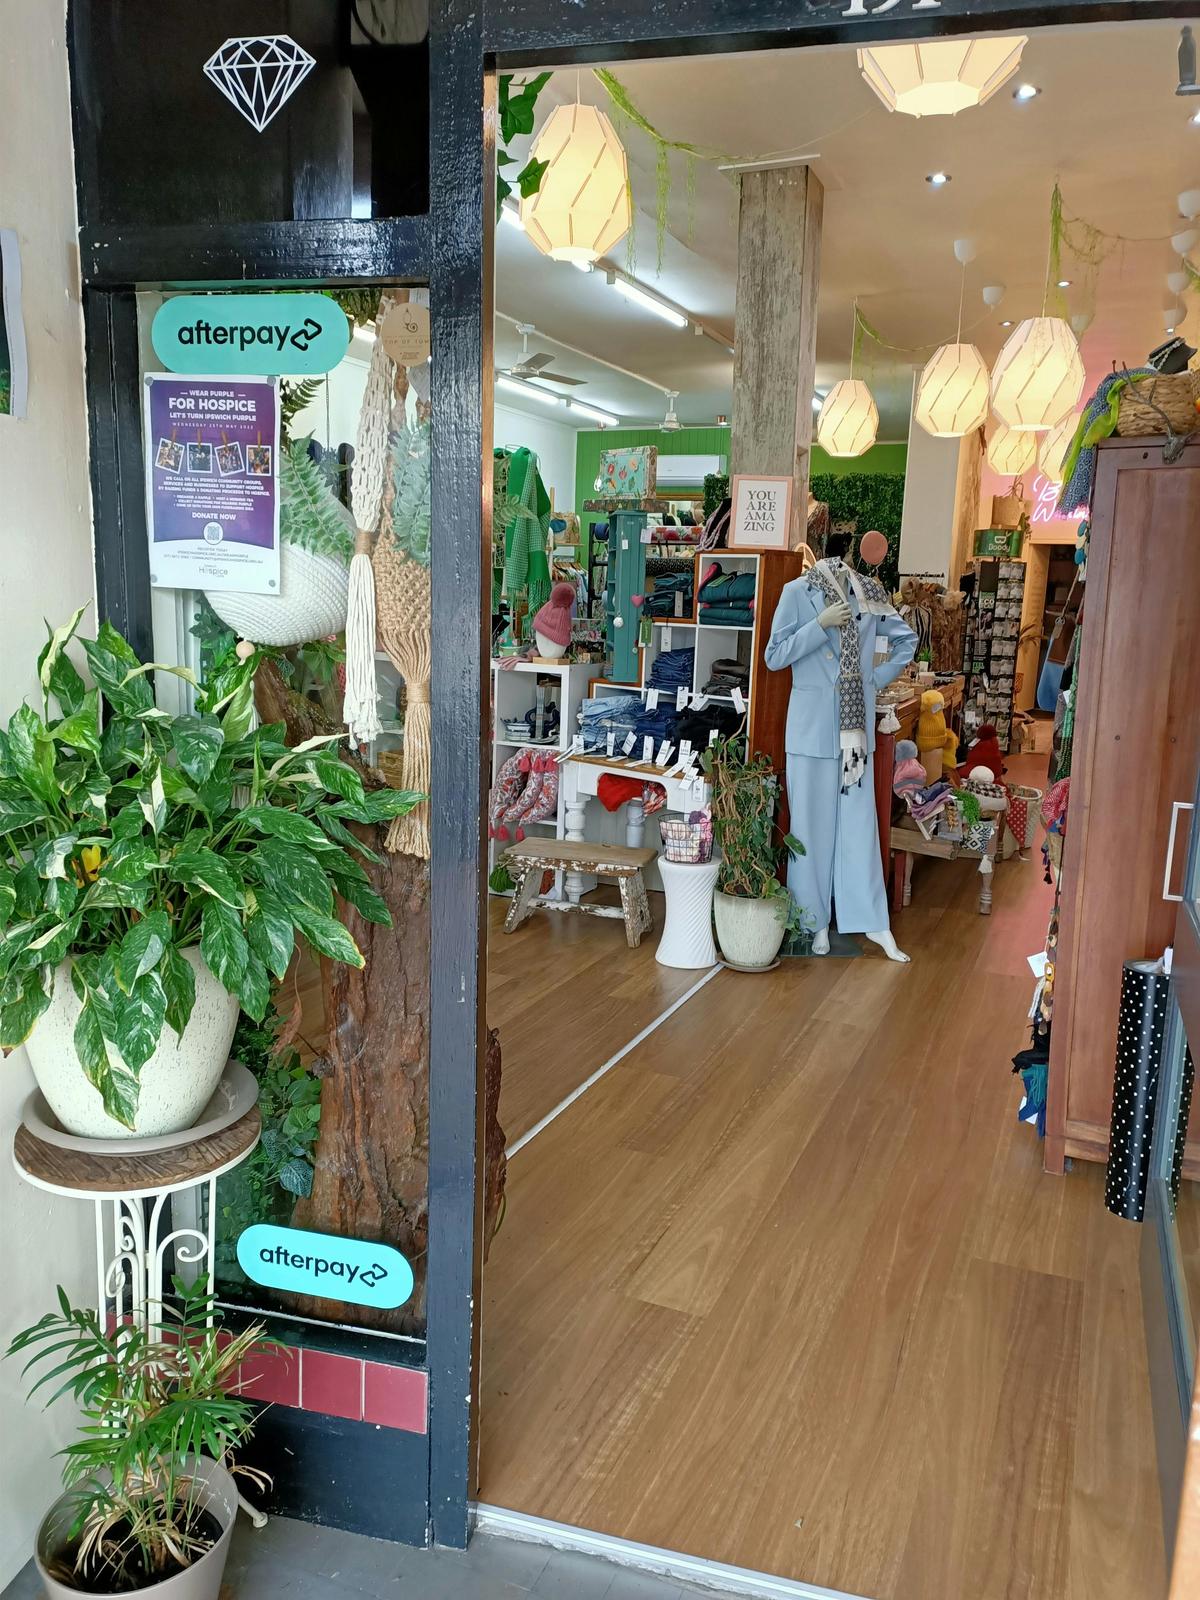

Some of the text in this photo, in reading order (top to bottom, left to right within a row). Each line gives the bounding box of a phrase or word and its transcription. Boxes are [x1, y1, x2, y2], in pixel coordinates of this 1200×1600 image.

[178, 319, 290, 351] afterpay
[168, 398, 256, 412] FOR HOSPICE
[748, 490, 776, 500] YOU
[746, 501, 776, 511] ARE
[745, 511, 775, 521] AMA
[743, 521, 775, 531] ZING
[199, 567, 228, 577] Hspice
[259, 1246, 360, 1283] afterpay
